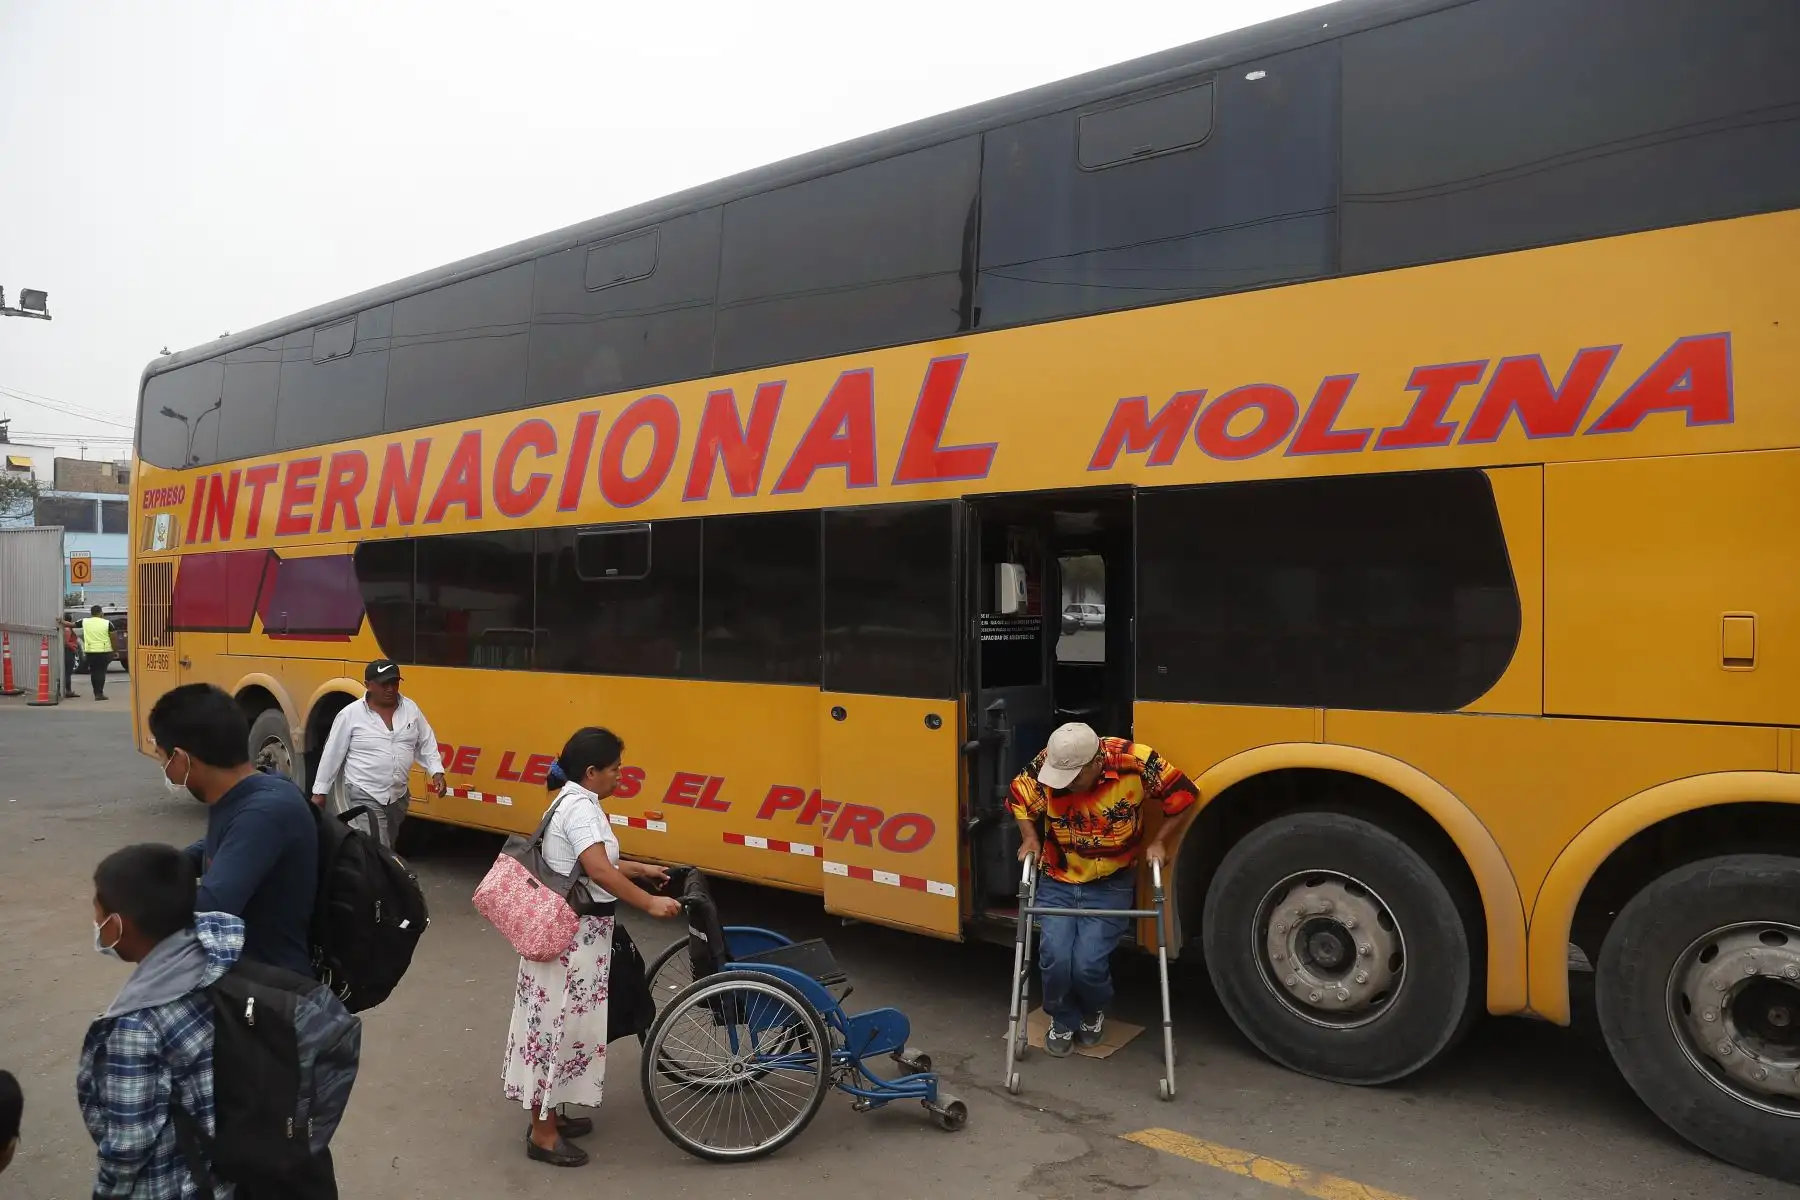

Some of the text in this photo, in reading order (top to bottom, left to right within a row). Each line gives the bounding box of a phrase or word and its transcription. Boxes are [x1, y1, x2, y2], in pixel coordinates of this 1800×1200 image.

[185, 331, 1735, 545] INTERNACIONAL MOLINA
[143, 484, 185, 509] EXPRESO
[496, 751, 646, 798] LES
[662, 772, 732, 812] EL
